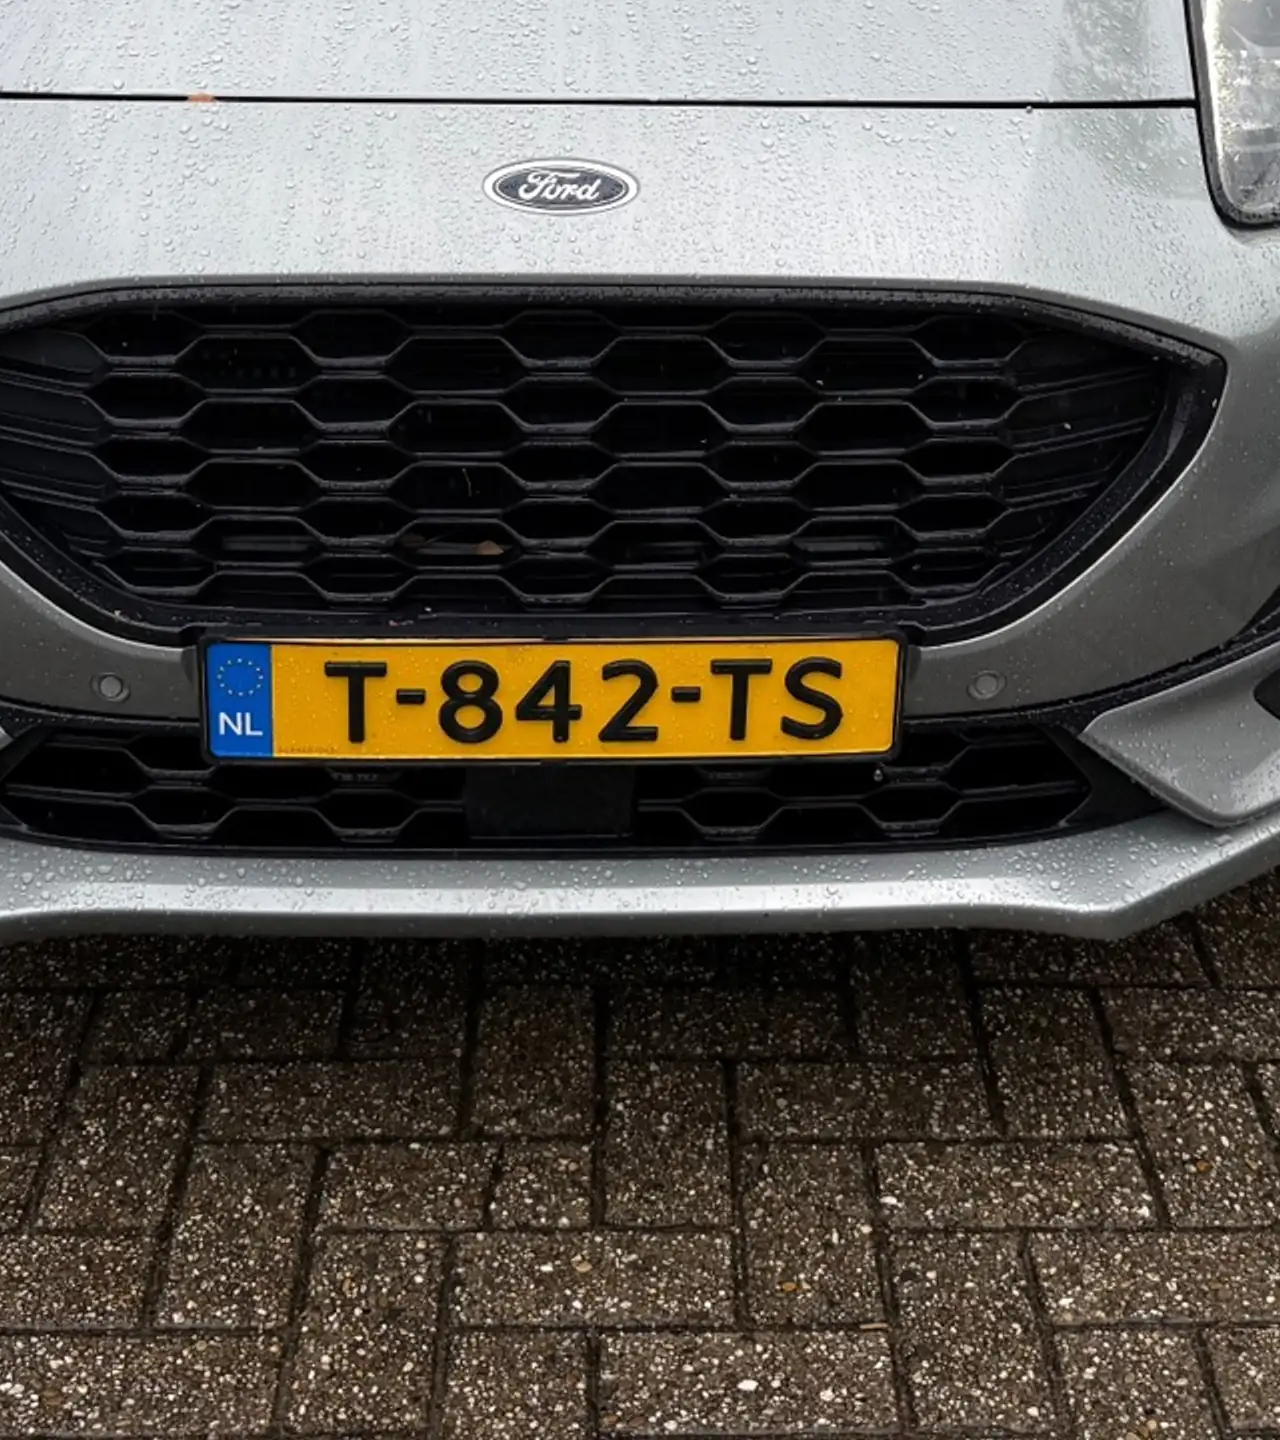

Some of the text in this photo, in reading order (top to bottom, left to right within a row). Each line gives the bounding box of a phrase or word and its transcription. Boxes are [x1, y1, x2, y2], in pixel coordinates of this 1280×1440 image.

[518, 170, 602, 201] Ford
[218, 656, 844, 744] NL T-842-TS
